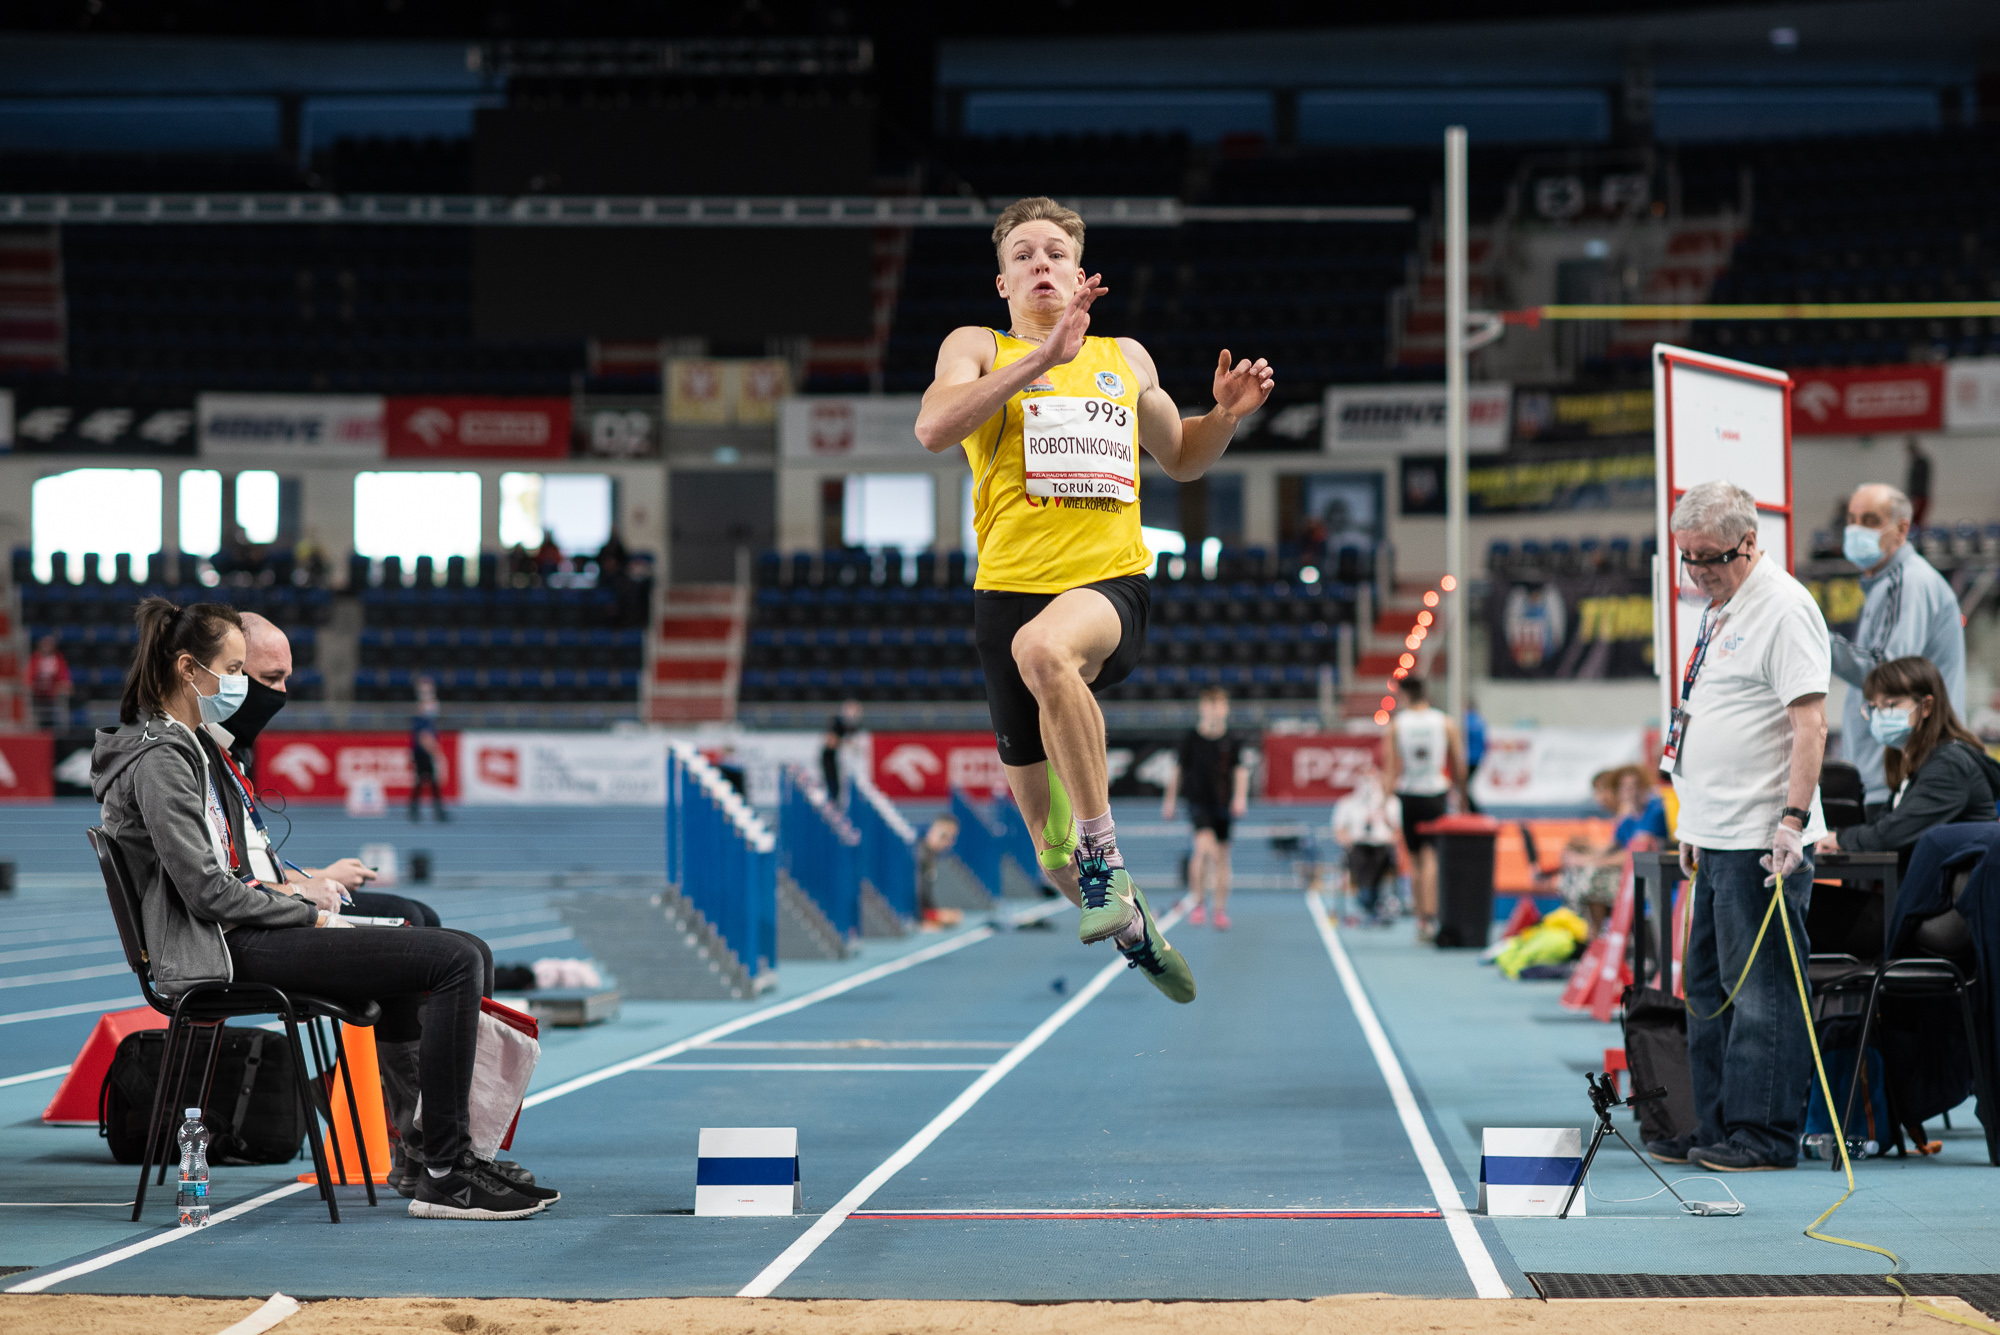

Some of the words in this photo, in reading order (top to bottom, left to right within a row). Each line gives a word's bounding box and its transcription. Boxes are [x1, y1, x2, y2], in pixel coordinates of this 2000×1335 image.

[1085, 400, 1127, 427] 993
[1029, 437, 1131, 462] ROBOTNIKOWSKI
[1052, 480, 1093, 493] TORUŃ
[1097, 483, 1120, 495] 2021
[1063, 499, 1122, 515] WIELKOPOLSKI
